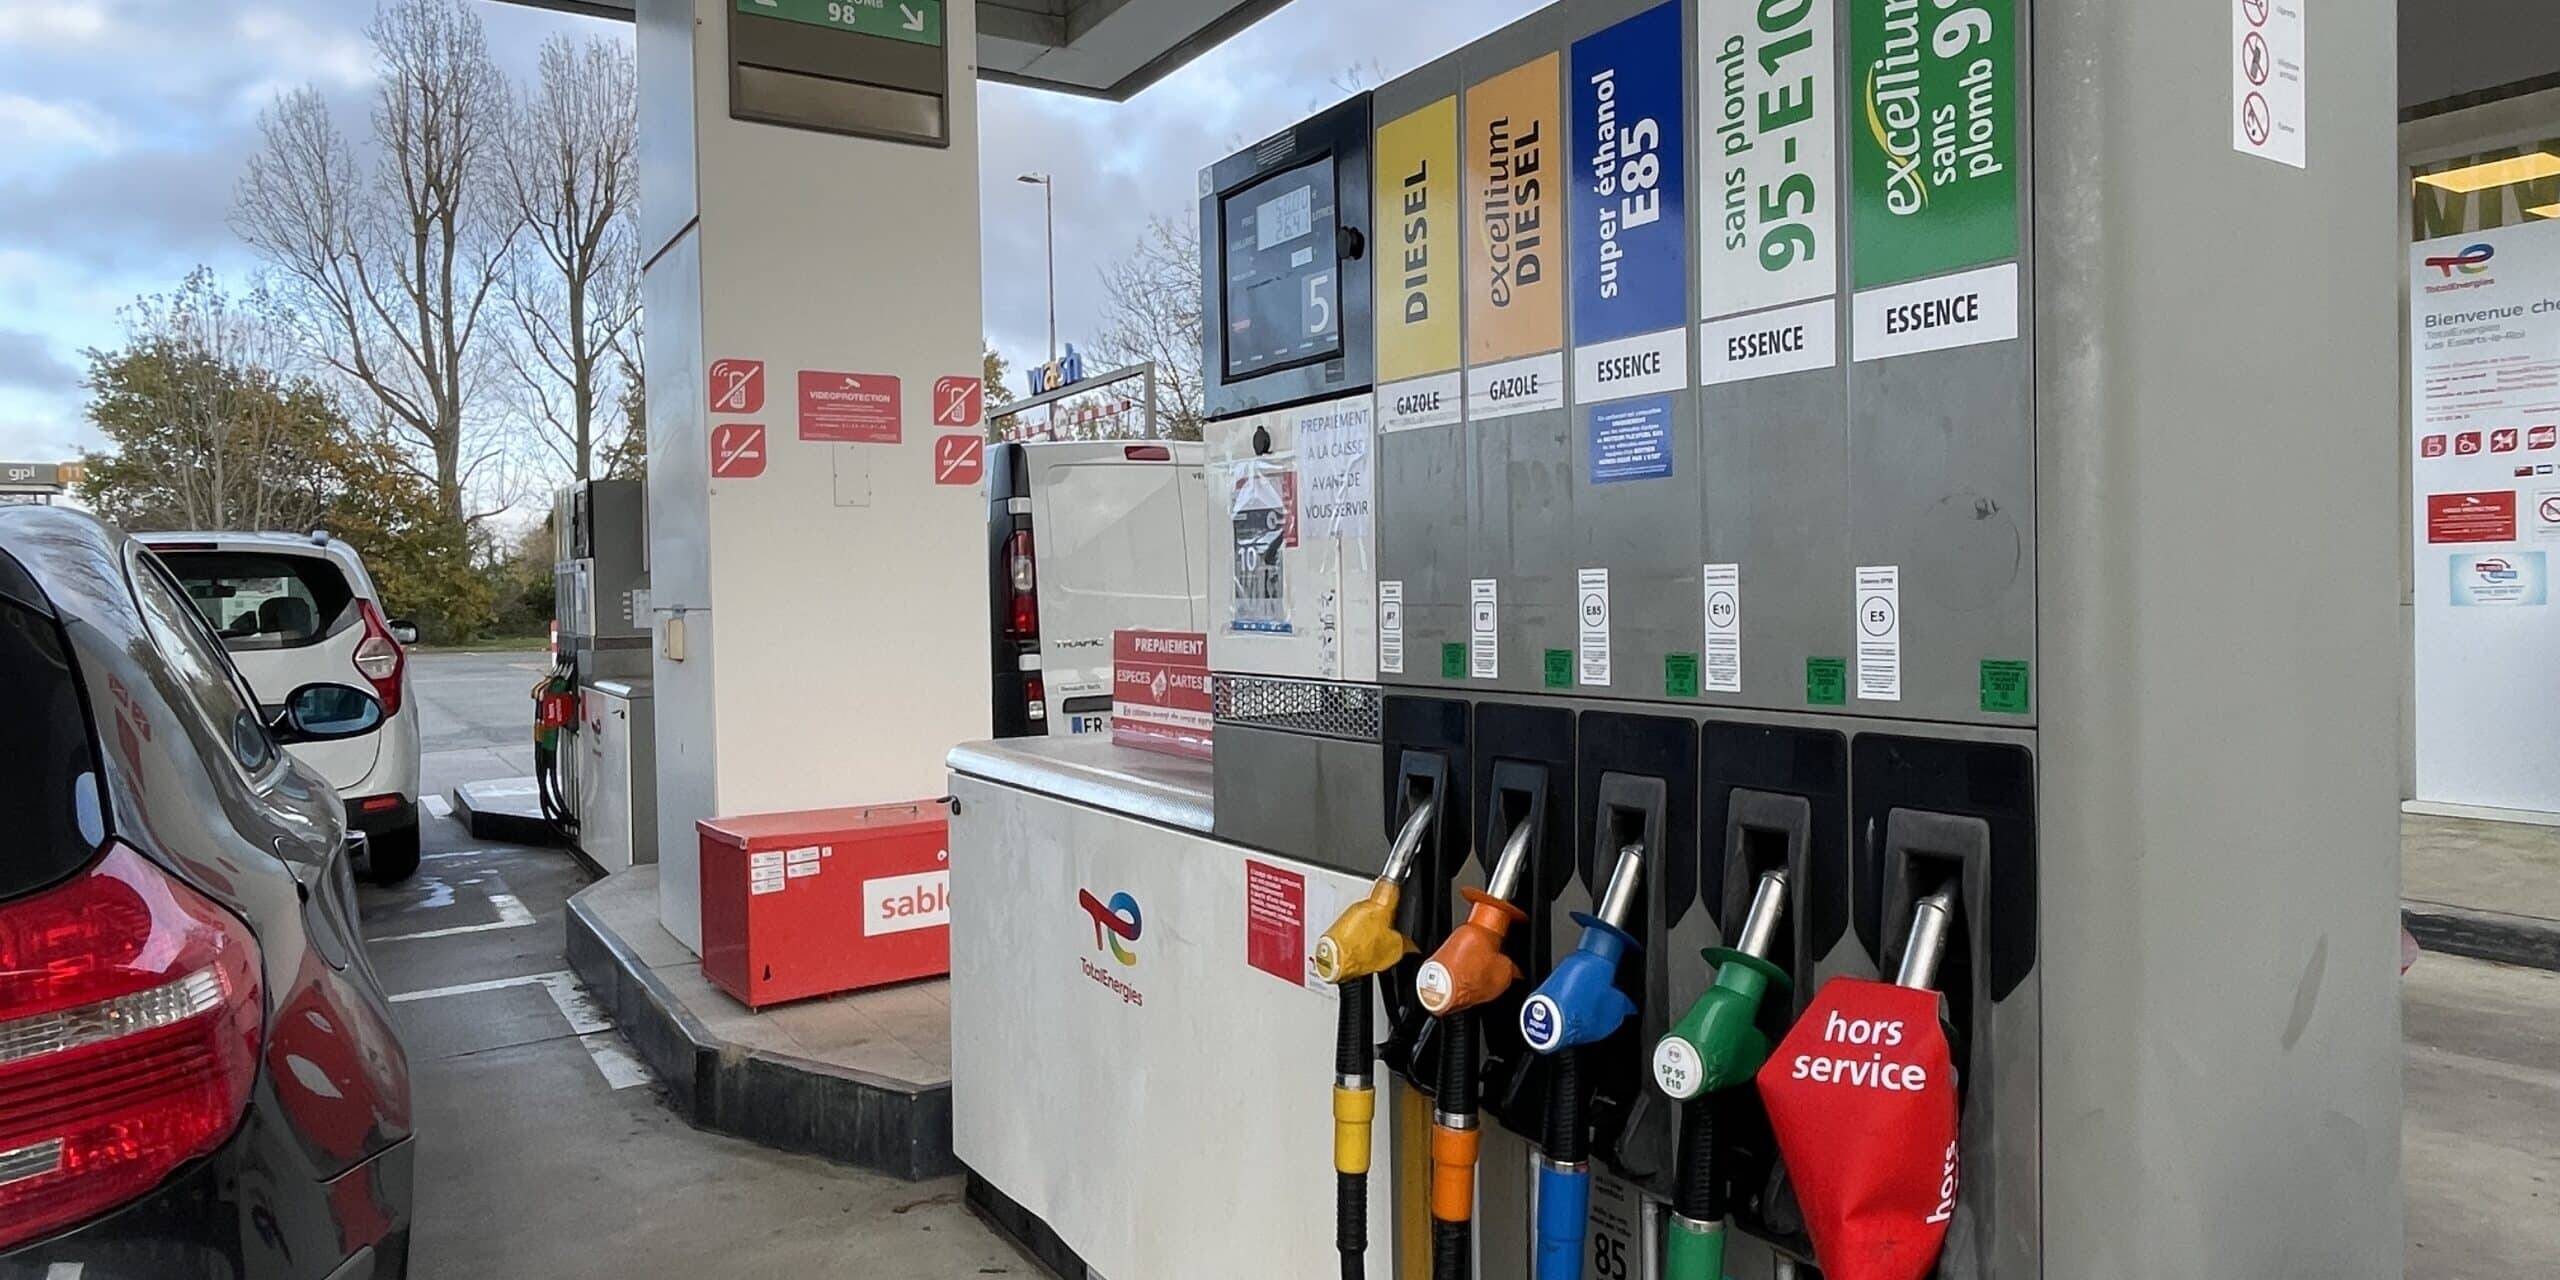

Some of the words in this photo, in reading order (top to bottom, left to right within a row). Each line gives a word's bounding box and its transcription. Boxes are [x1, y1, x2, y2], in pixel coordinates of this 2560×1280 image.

[828, 3, 855, 24] 98
[1932, 0, 1992, 58] 9
[1716, 34, 1753, 156] plomb
[1592, 68, 1615, 196] éthanol
[1959, 58, 2002, 178] plomb
[1933, 104, 1956, 186] sans
[1621, 117, 1660, 230] E85
[1484, 116, 1511, 308] excellium
[1514, 120, 1541, 286] DIESEL
[1725, 167, 1746, 251] sans
[1404, 160, 1428, 323] DIESEL
[1600, 208, 1622, 299] super
[1310, 275, 1329, 333] 5
[1886, 294, 1979, 335] ESSENCE
[2425, 305, 2524, 328] Bienvenue
[1728, 326, 1803, 361] ESSENCE
[1027, 343, 1082, 395] wash
[1598, 352, 1661, 383] ESSENCE
[810, 391, 891, 403] VIDEOPROTECTION
[1397, 391, 1440, 416] GAZOLE
[1490, 374, 1538, 401] GAZOLE
[1301, 409, 1369, 433] PREPAIEMENT
[1318, 446, 1328, 459] LA
[1331, 440, 1363, 457] CAISSE
[8, 466, 36, 480] gpl
[1312, 474, 1345, 490] AVANT
[1347, 472, 1360, 487] DE
[1305, 505, 1331, 519] VOUS
[1238, 547, 1257, 571] 10
[1586, 605, 1601, 616] E85
[1713, 604, 1731, 615] E10
[1870, 611, 1885, 622] E5
[1135, 638, 1204, 655] PREPAIEMENT
[1117, 669, 1151, 684] ESPECES
[1170, 674, 1203, 690] CARTES
[881, 882, 950, 920] sabl
[1080, 956, 1143, 1007] TotalEnergies
[1824, 1010, 1904, 1046] hors
[1662, 1064, 1673, 1075] SP
[1674, 1069, 1686, 1080] 95
[1666, 1077, 1681, 1090] E10
[1792, 1053, 1927, 1090] service
[1926, 1140, 1959, 1225] hors
[1595, 1232, 1626, 1280] 85
